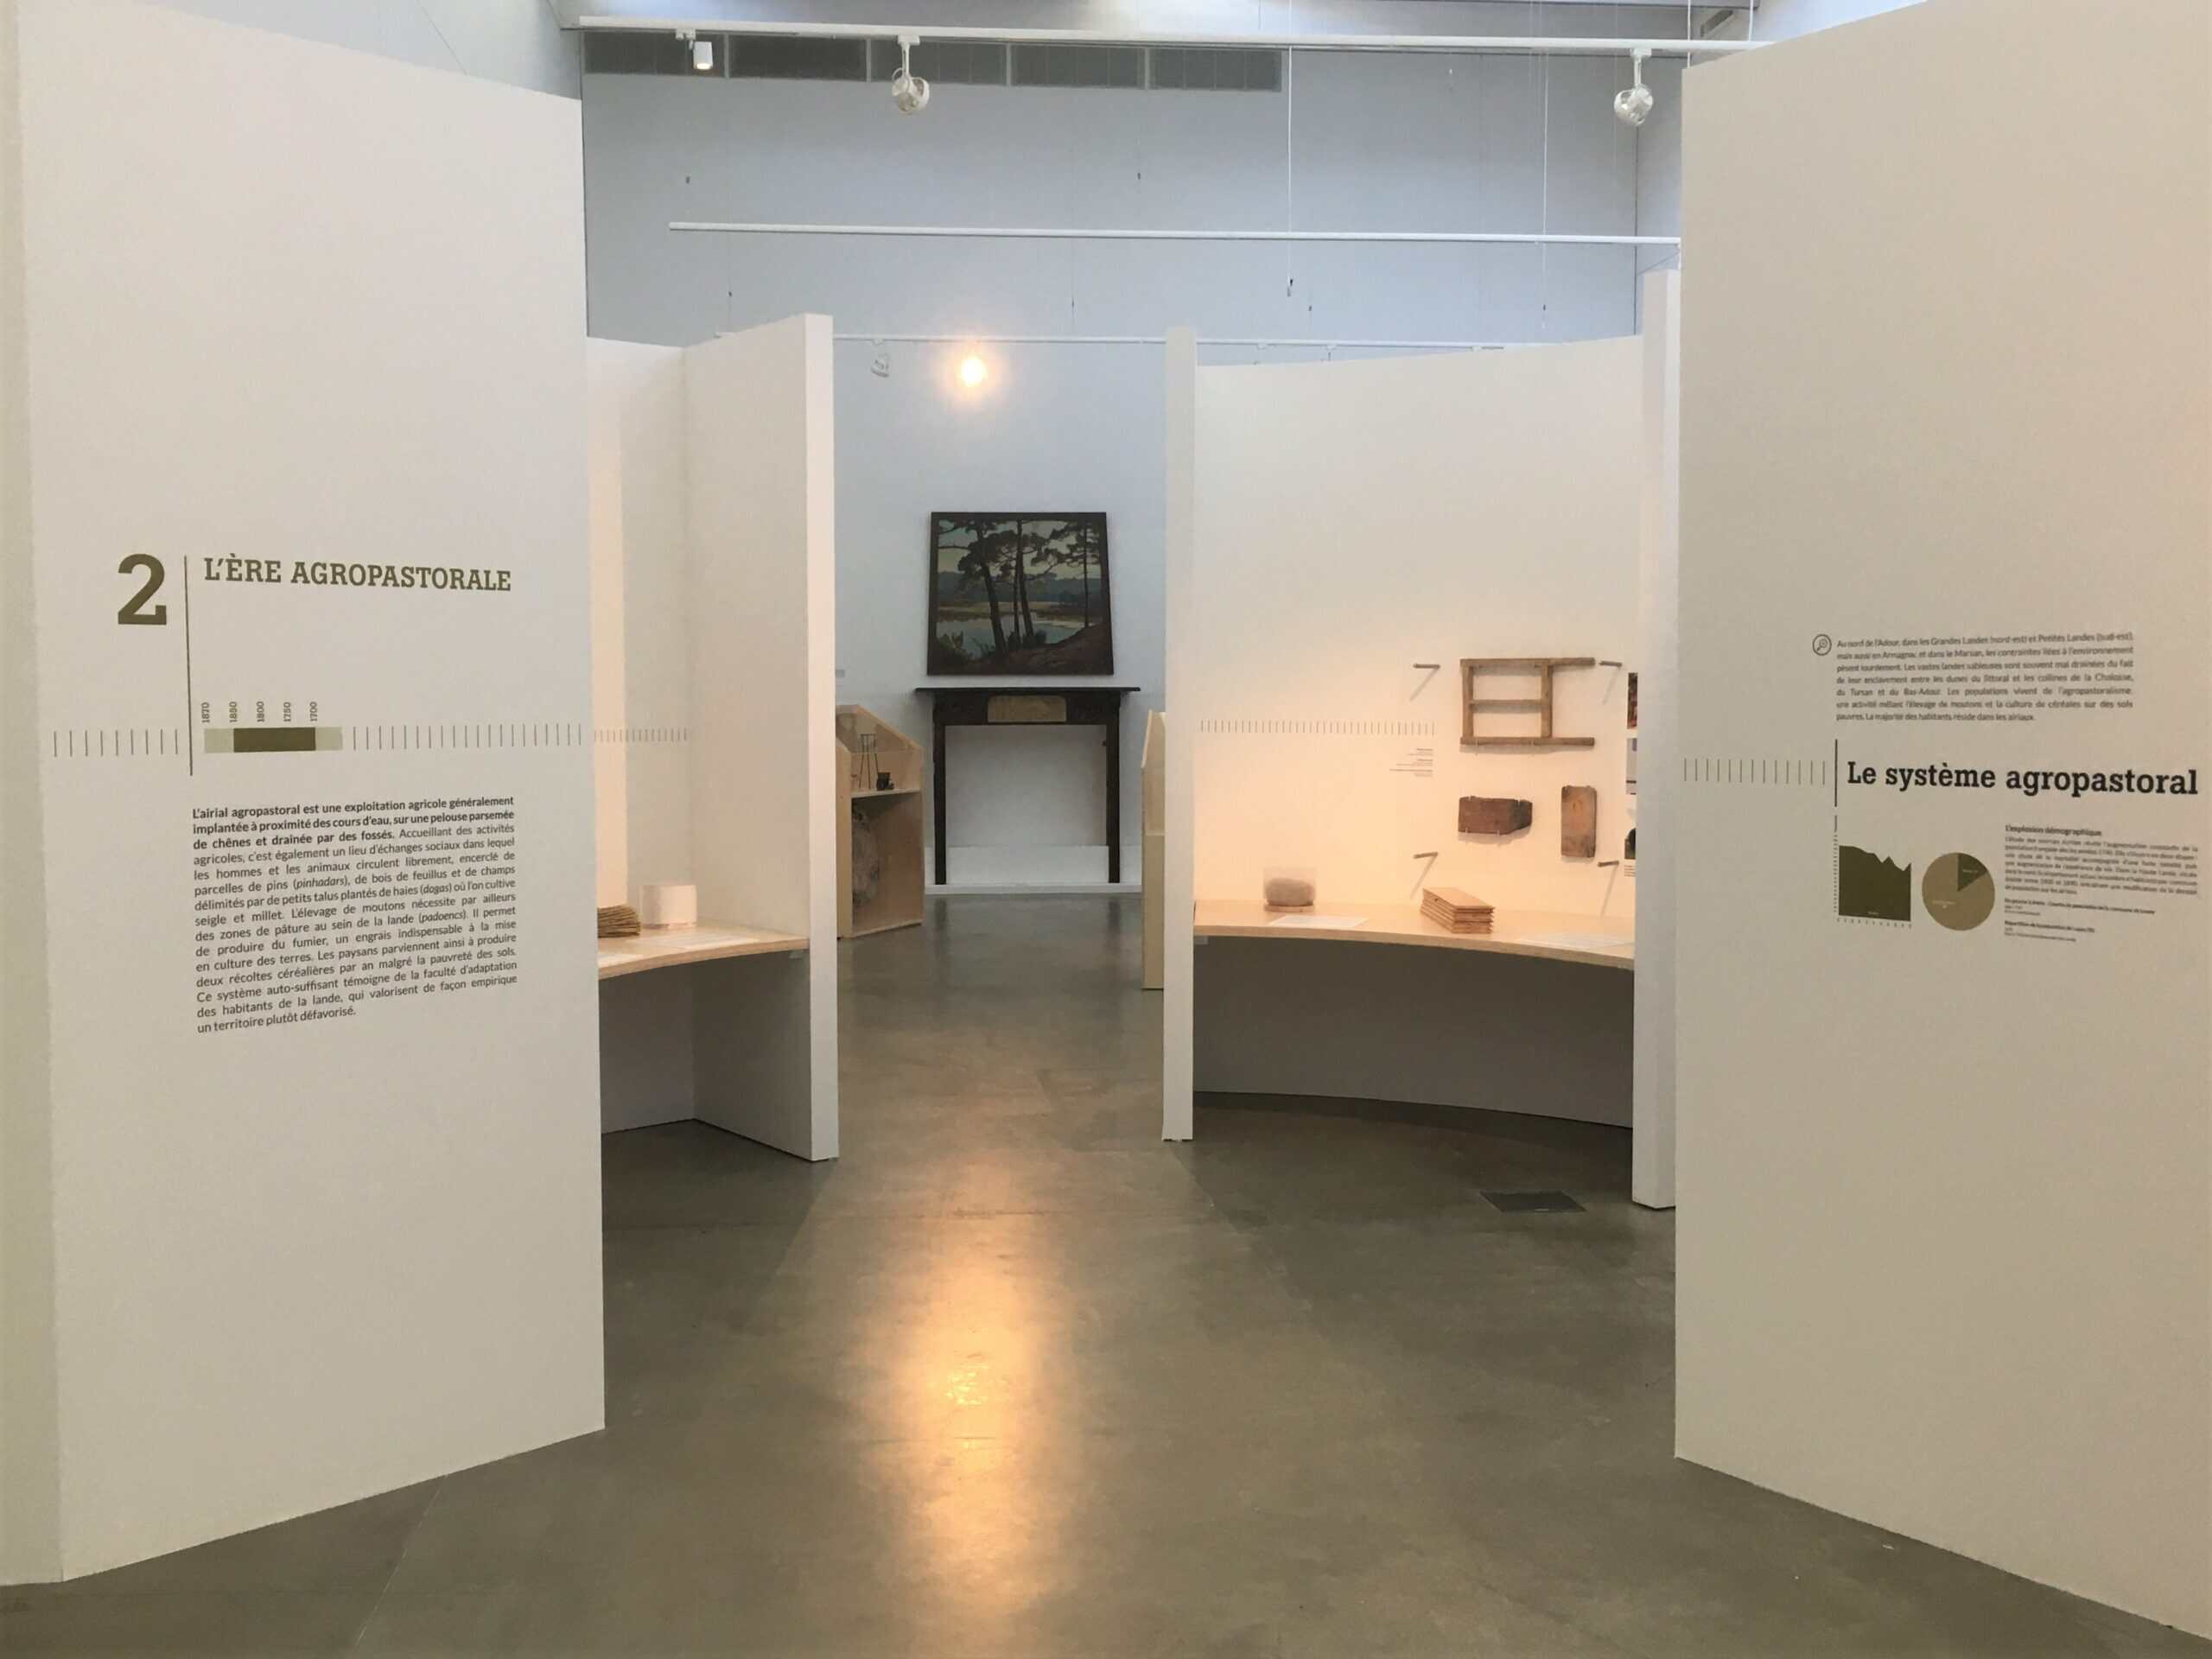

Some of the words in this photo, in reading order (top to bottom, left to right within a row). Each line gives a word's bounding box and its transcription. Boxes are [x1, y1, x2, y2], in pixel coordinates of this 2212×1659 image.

[204, 553, 282, 583] L'ÈRE
[291, 562, 512, 592] AGROPASTORALE
[118, 553, 167, 626] 2
[201, 702, 210, 723] 1870
[257, 701, 265, 722] 1800
[1847, 761, 1877, 785] Le
[1885, 762, 1996, 791] système
[2005, 769, 2198, 798] agropastoral
[193, 821, 249, 836] implantée
[251, 820, 257, 831] à
[259, 818, 311, 833] proximité
[313, 817, 331, 829] des
[333, 818, 361, 828] cours
[410, 816, 429, 824] une
[430, 812, 467, 825] pelouse
[468, 809, 514, 823] parsemée
[232, 804, 300, 819] agropastoral
[303, 804, 319, 814] est
[344, 800, 405, 814] exploitation
[408, 798, 447, 812] agricole
[448, 796, 513, 810] généralement
[193, 838, 207, 849] de
[212, 836, 251, 849] chênes
[256, 836, 267, 846] et
[271, 833, 312, 845] drainée
[317, 835, 334, 846] par
[339, 831, 357, 842] des
[399, 827, 452, 839] Accueillant
[456, 825, 472, 836] des
[476, 823, 514, 836] activités
[275, 848, 329, 861] également
[348, 845, 366, 855] lieu
[425, 840, 461, 852] sociaux
[462, 839, 485, 849] dans
[486, 836, 515, 850] lequel
[194, 869, 209, 880] les
[216, 868, 262, 879] hommes
[268, 866, 279, 875] et
[286, 863, 301, 874] les
[307, 861, 350, 873] animaux
[356, 858, 400, 870] circulent
[459, 851, 499, 864] encerclé
[503, 850, 515, 861] de
[194, 882, 244, 898] parcelles
[248, 880, 262, 892] de
[266, 880, 288, 893] pins
[354, 874, 367, 885] de
[372, 873, 392, 884] bois
[396, 872, 409, 882] de
[412, 869, 447, 881] feuillus
[451, 869, 461, 879] et
[465, 868, 477, 878] de
[480, 866, 515, 878] champs
[195, 913, 226, 926] seigle
[233, 912, 245, 923] et
[343, 904, 356, 914] de
[362, 902, 405, 912] moutons
[411, 896, 455, 909] nécessite
[461, 897, 476, 908] par
[483, 893, 516, 904] ailleurs
[195, 946, 210, 957] de
[217, 942, 264, 957] produire
[271, 939, 285, 950] du
[355, 931, 391, 944] engrais
[397, 924, 462, 940] indispensable
[468, 923, 474, 933] à
[480, 922, 489, 932] la
[495, 920, 516, 931] mise
[195, 963, 210, 972] en
[213, 958, 253, 970] culture
[257, 956, 276, 966] des
[317, 950, 334, 961] Les
[338, 948, 378, 962] paysans
[381, 941, 440, 957] parviennent
[443, 937, 465, 949] ainsi
[468, 936, 474, 947] à
[477, 933, 517, 949] produire
[196, 976, 224, 987] deux
[229, 971, 272, 984] récoltes
[277, 965, 334, 979] céréalières
[340, 965, 356, 976] par
[378, 957, 412, 971] malgré
[416, 956, 426, 967] la
[429, 951, 473, 968] pauvreté
[476, 950, 493, 961] des
[196, 991, 212, 1002] Ce
[217, 988, 262, 1002] système
[267, 979, 338, 995] auto-suffisant
[343, 975, 390, 988] témoigne
[394, 971, 406, 982] de
[410, 970, 419, 981] la
[423, 966, 456, 979] faculté
[197, 1007, 216, 1017] des
[222, 1001, 273, 1014] habitants
[278, 998, 292, 1008] de
[297, 995, 307, 1007] la
[348, 989, 364, 1003] qui
[370, 985, 418, 999] valorisent
[423, 982, 435, 993] de
[440, 981, 467, 993] façon
[471, 975, 517, 989] empirique
[197, 1024, 212, 1033] un
[213, 1016, 264, 1031] territoire
[266, 1012, 298, 1027] plutôt
